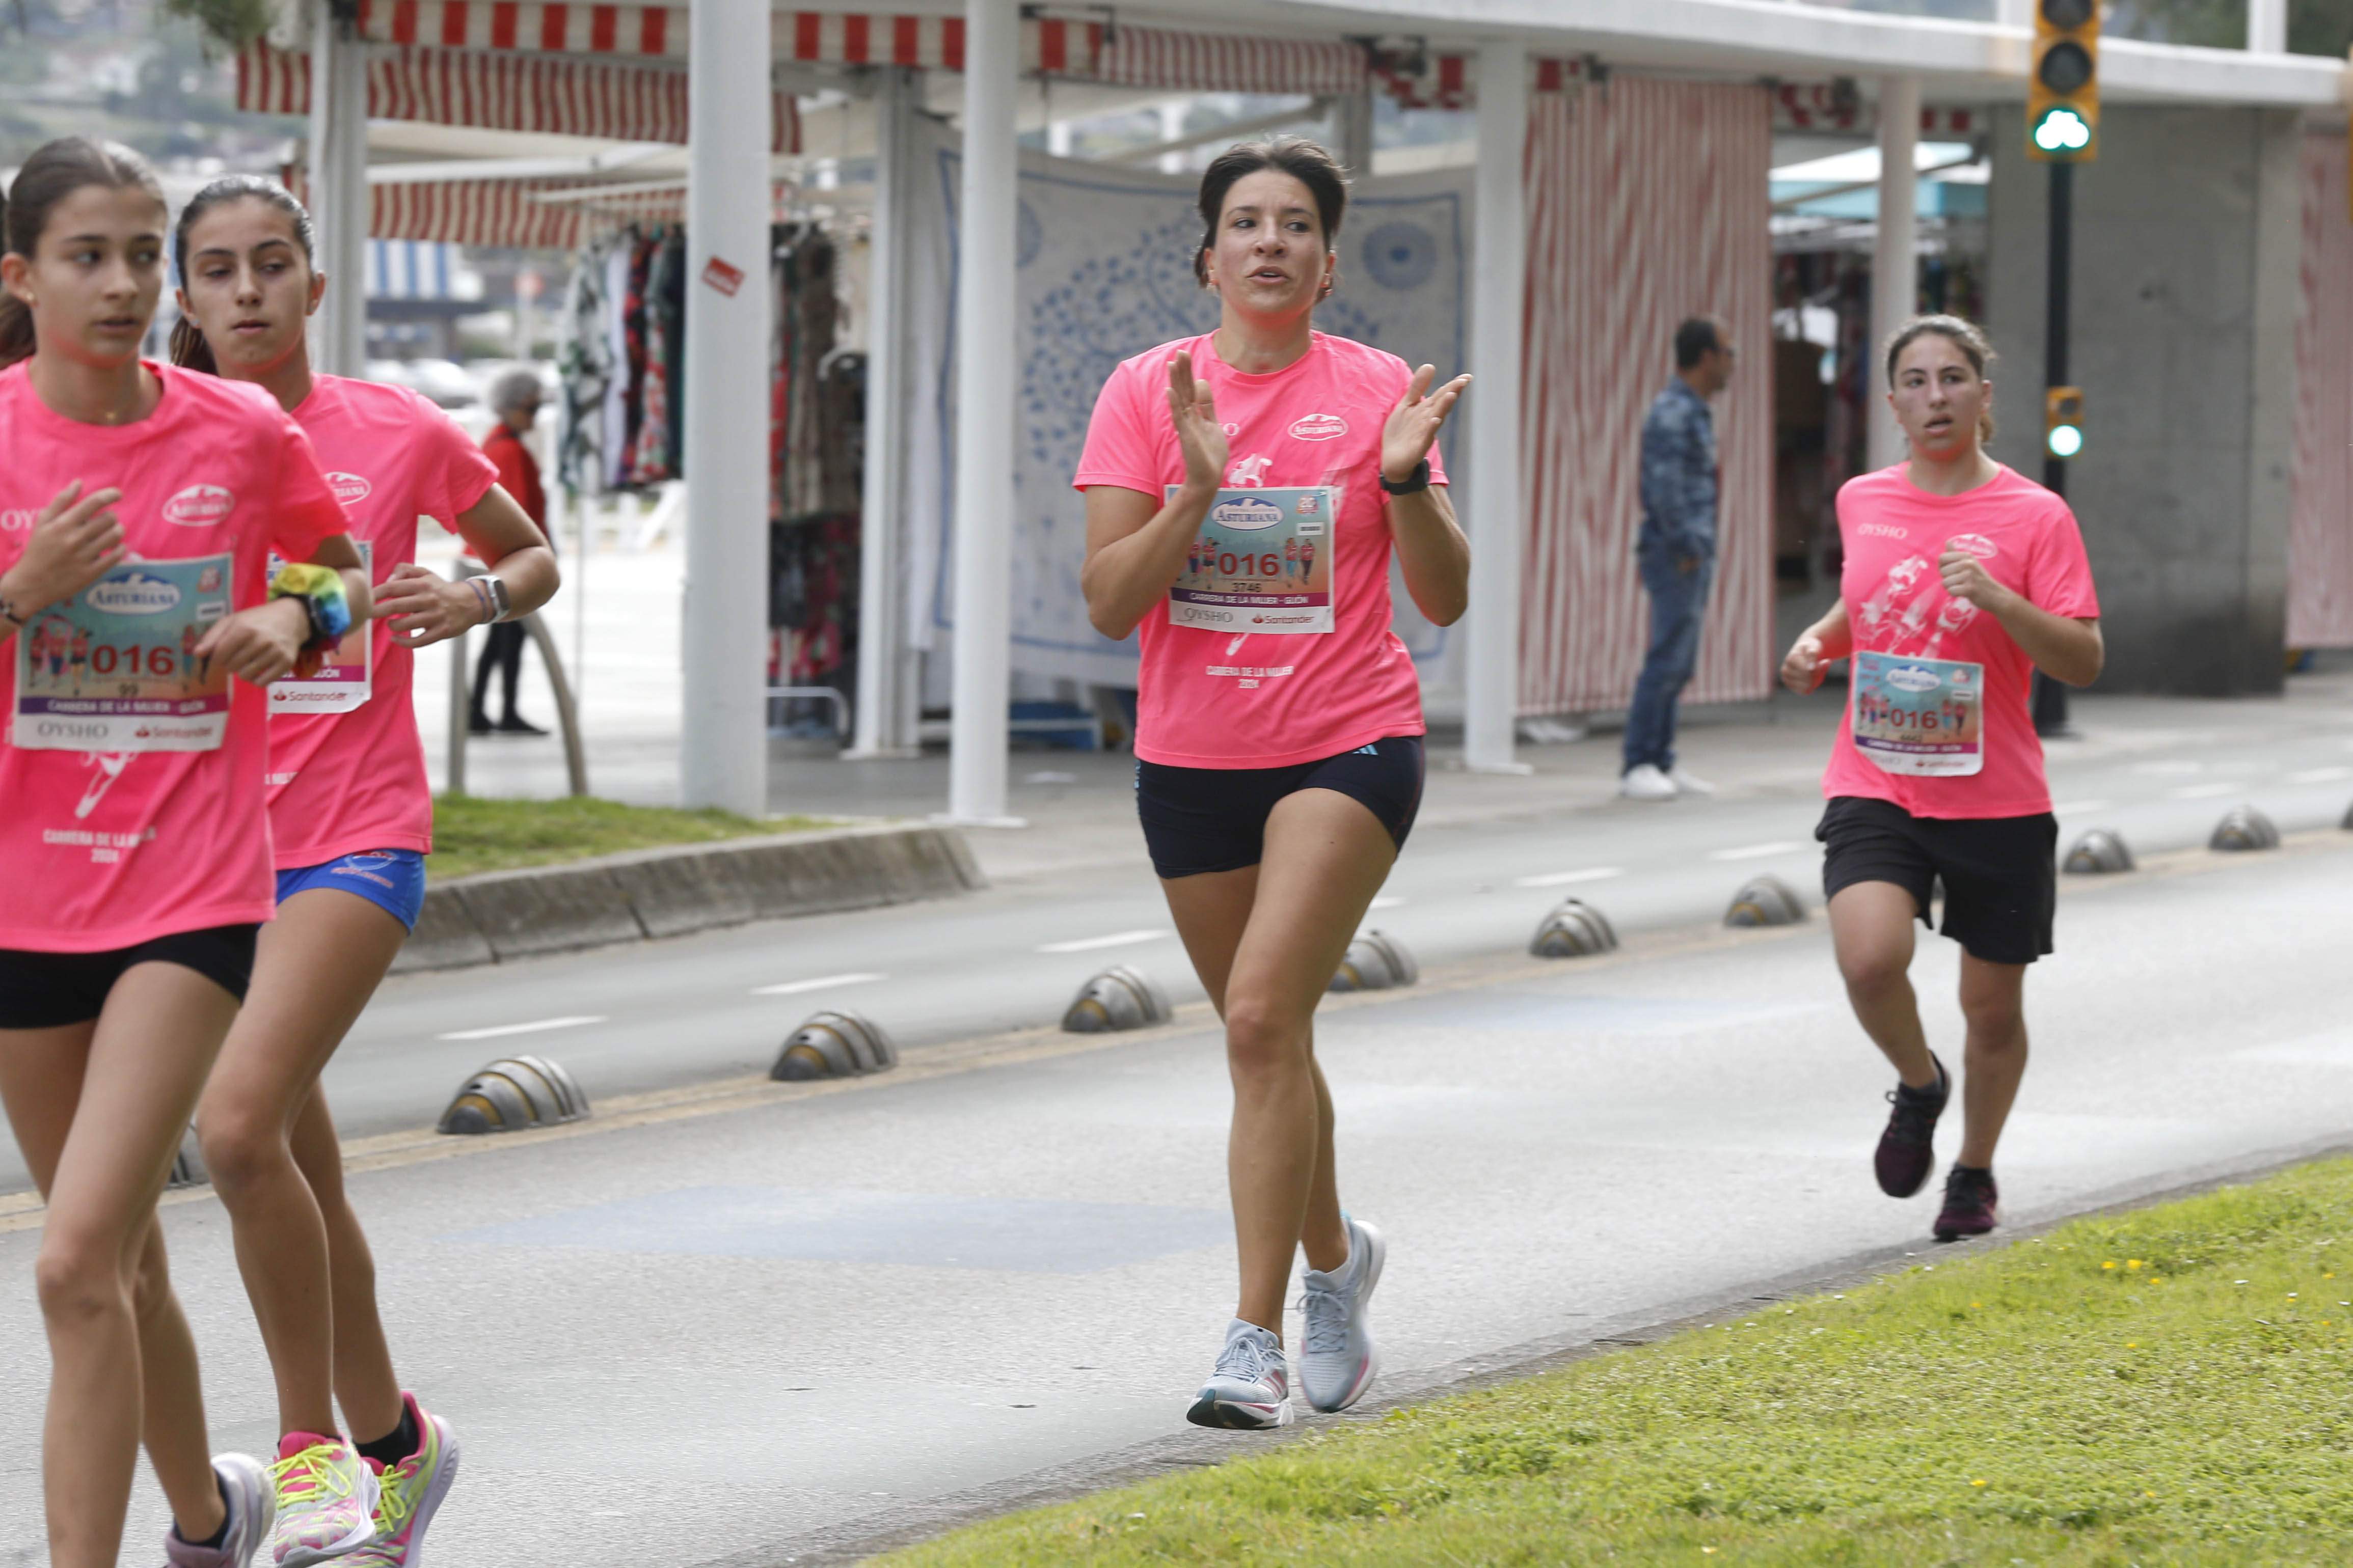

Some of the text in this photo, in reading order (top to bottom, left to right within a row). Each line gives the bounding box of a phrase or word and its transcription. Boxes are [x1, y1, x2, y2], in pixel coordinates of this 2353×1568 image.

[1216, 510, 1279, 522] ASTURIANA
[1858, 523, 1908, 539] OYSHO
[1219, 553, 1280, 576] 016
[1232, 582, 1262, 593] 3746
[1189, 592, 1224, 602] CARRERA
[1184, 608, 1233, 623] OYSHO
[1265, 615, 1314, 624] Santander
[91, 644, 175, 676] 016
[289, 691, 347, 701] Santander
[99, 700, 113, 712] DE
[1890, 708, 1938, 729] 016
[37, 722, 108, 738] OYSHO
